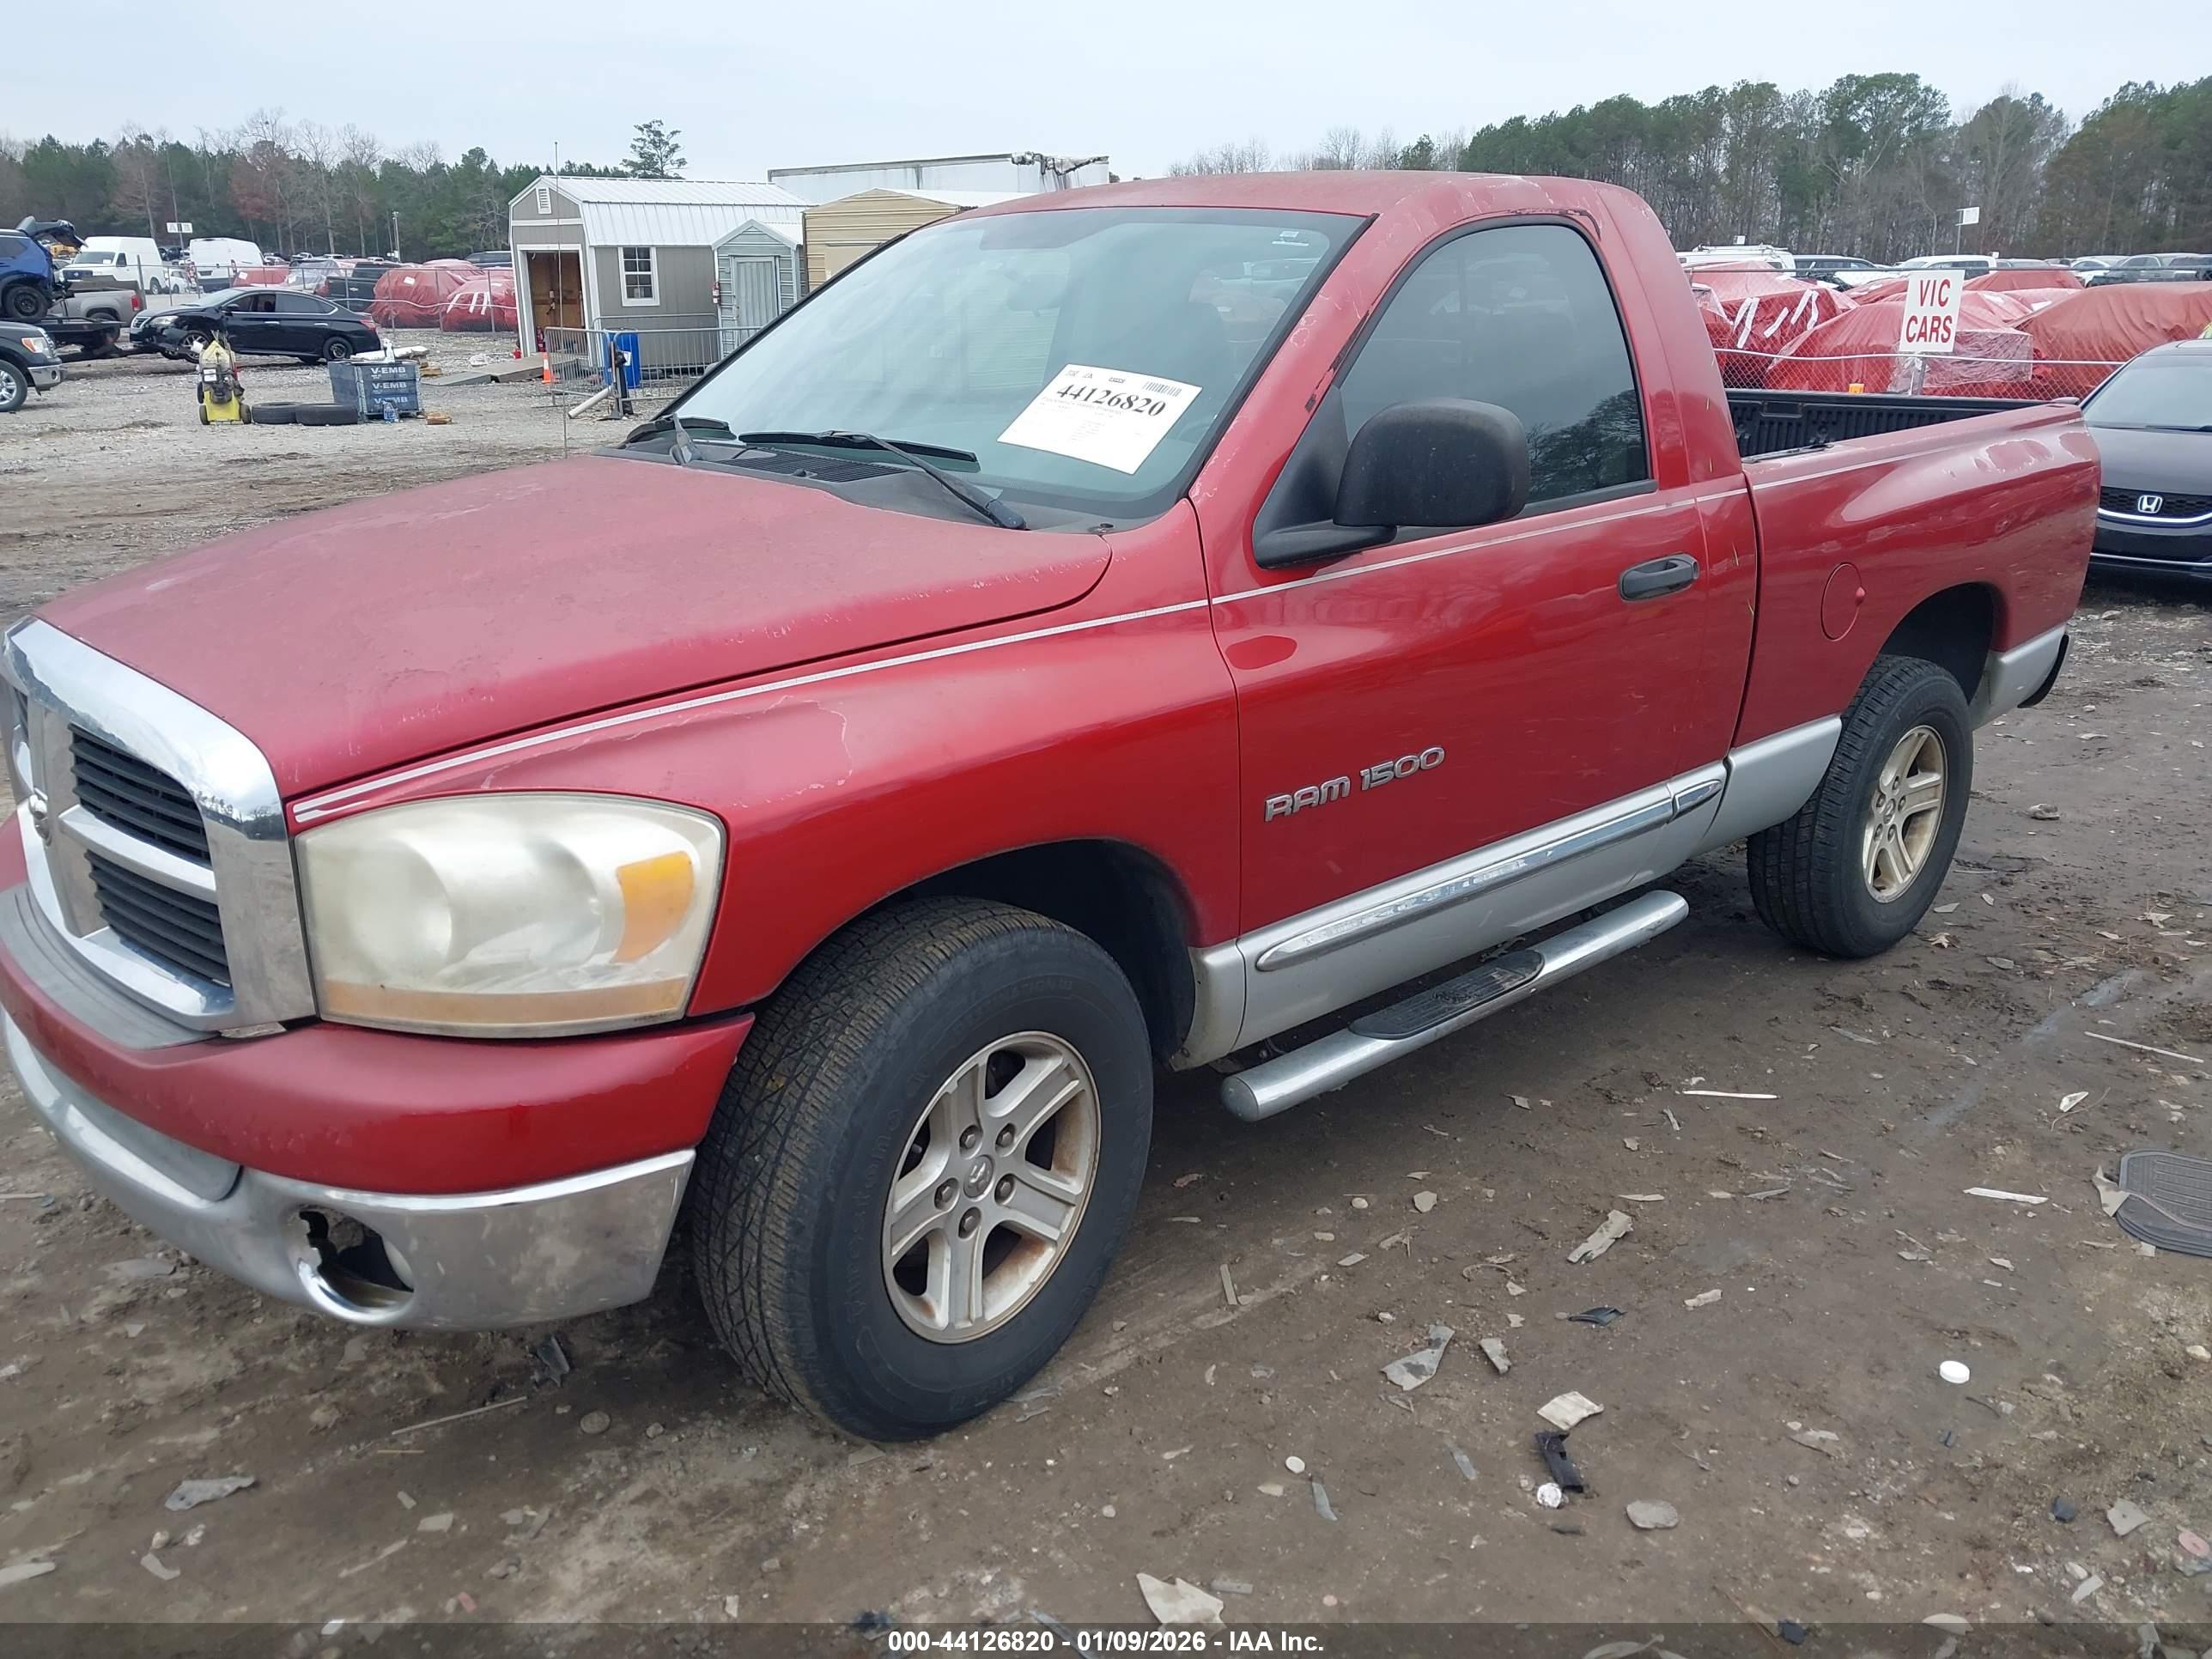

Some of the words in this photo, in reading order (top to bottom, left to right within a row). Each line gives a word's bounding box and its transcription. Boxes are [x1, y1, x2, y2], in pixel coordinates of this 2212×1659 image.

[1920, 278, 1951, 307] VIC
[1905, 315, 1953, 343] CARS
[1056, 384, 1166, 416] 44126820
[1264, 775, 1351, 822] RAM
[1360, 745, 1446, 791] 1500
